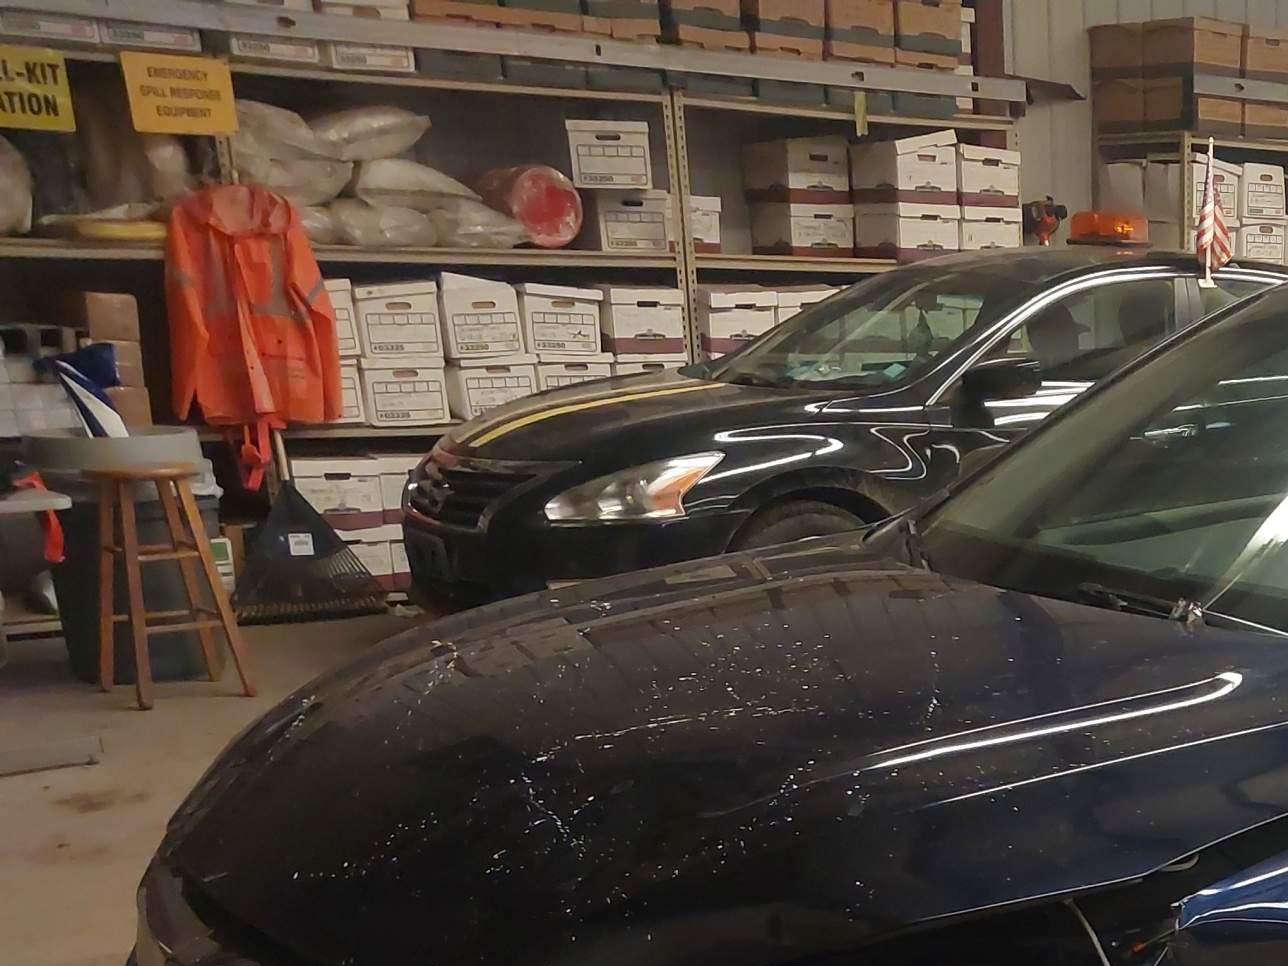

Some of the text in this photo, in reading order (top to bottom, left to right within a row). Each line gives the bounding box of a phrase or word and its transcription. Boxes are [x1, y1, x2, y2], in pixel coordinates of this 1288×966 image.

[0, 59, 60, 85] L-KIT
[146, 66, 208, 81] EMERGENCY
[140, 84, 221, 101] SPILL RESPONSE
[156, 104, 212, 118] EQUIPMENT
